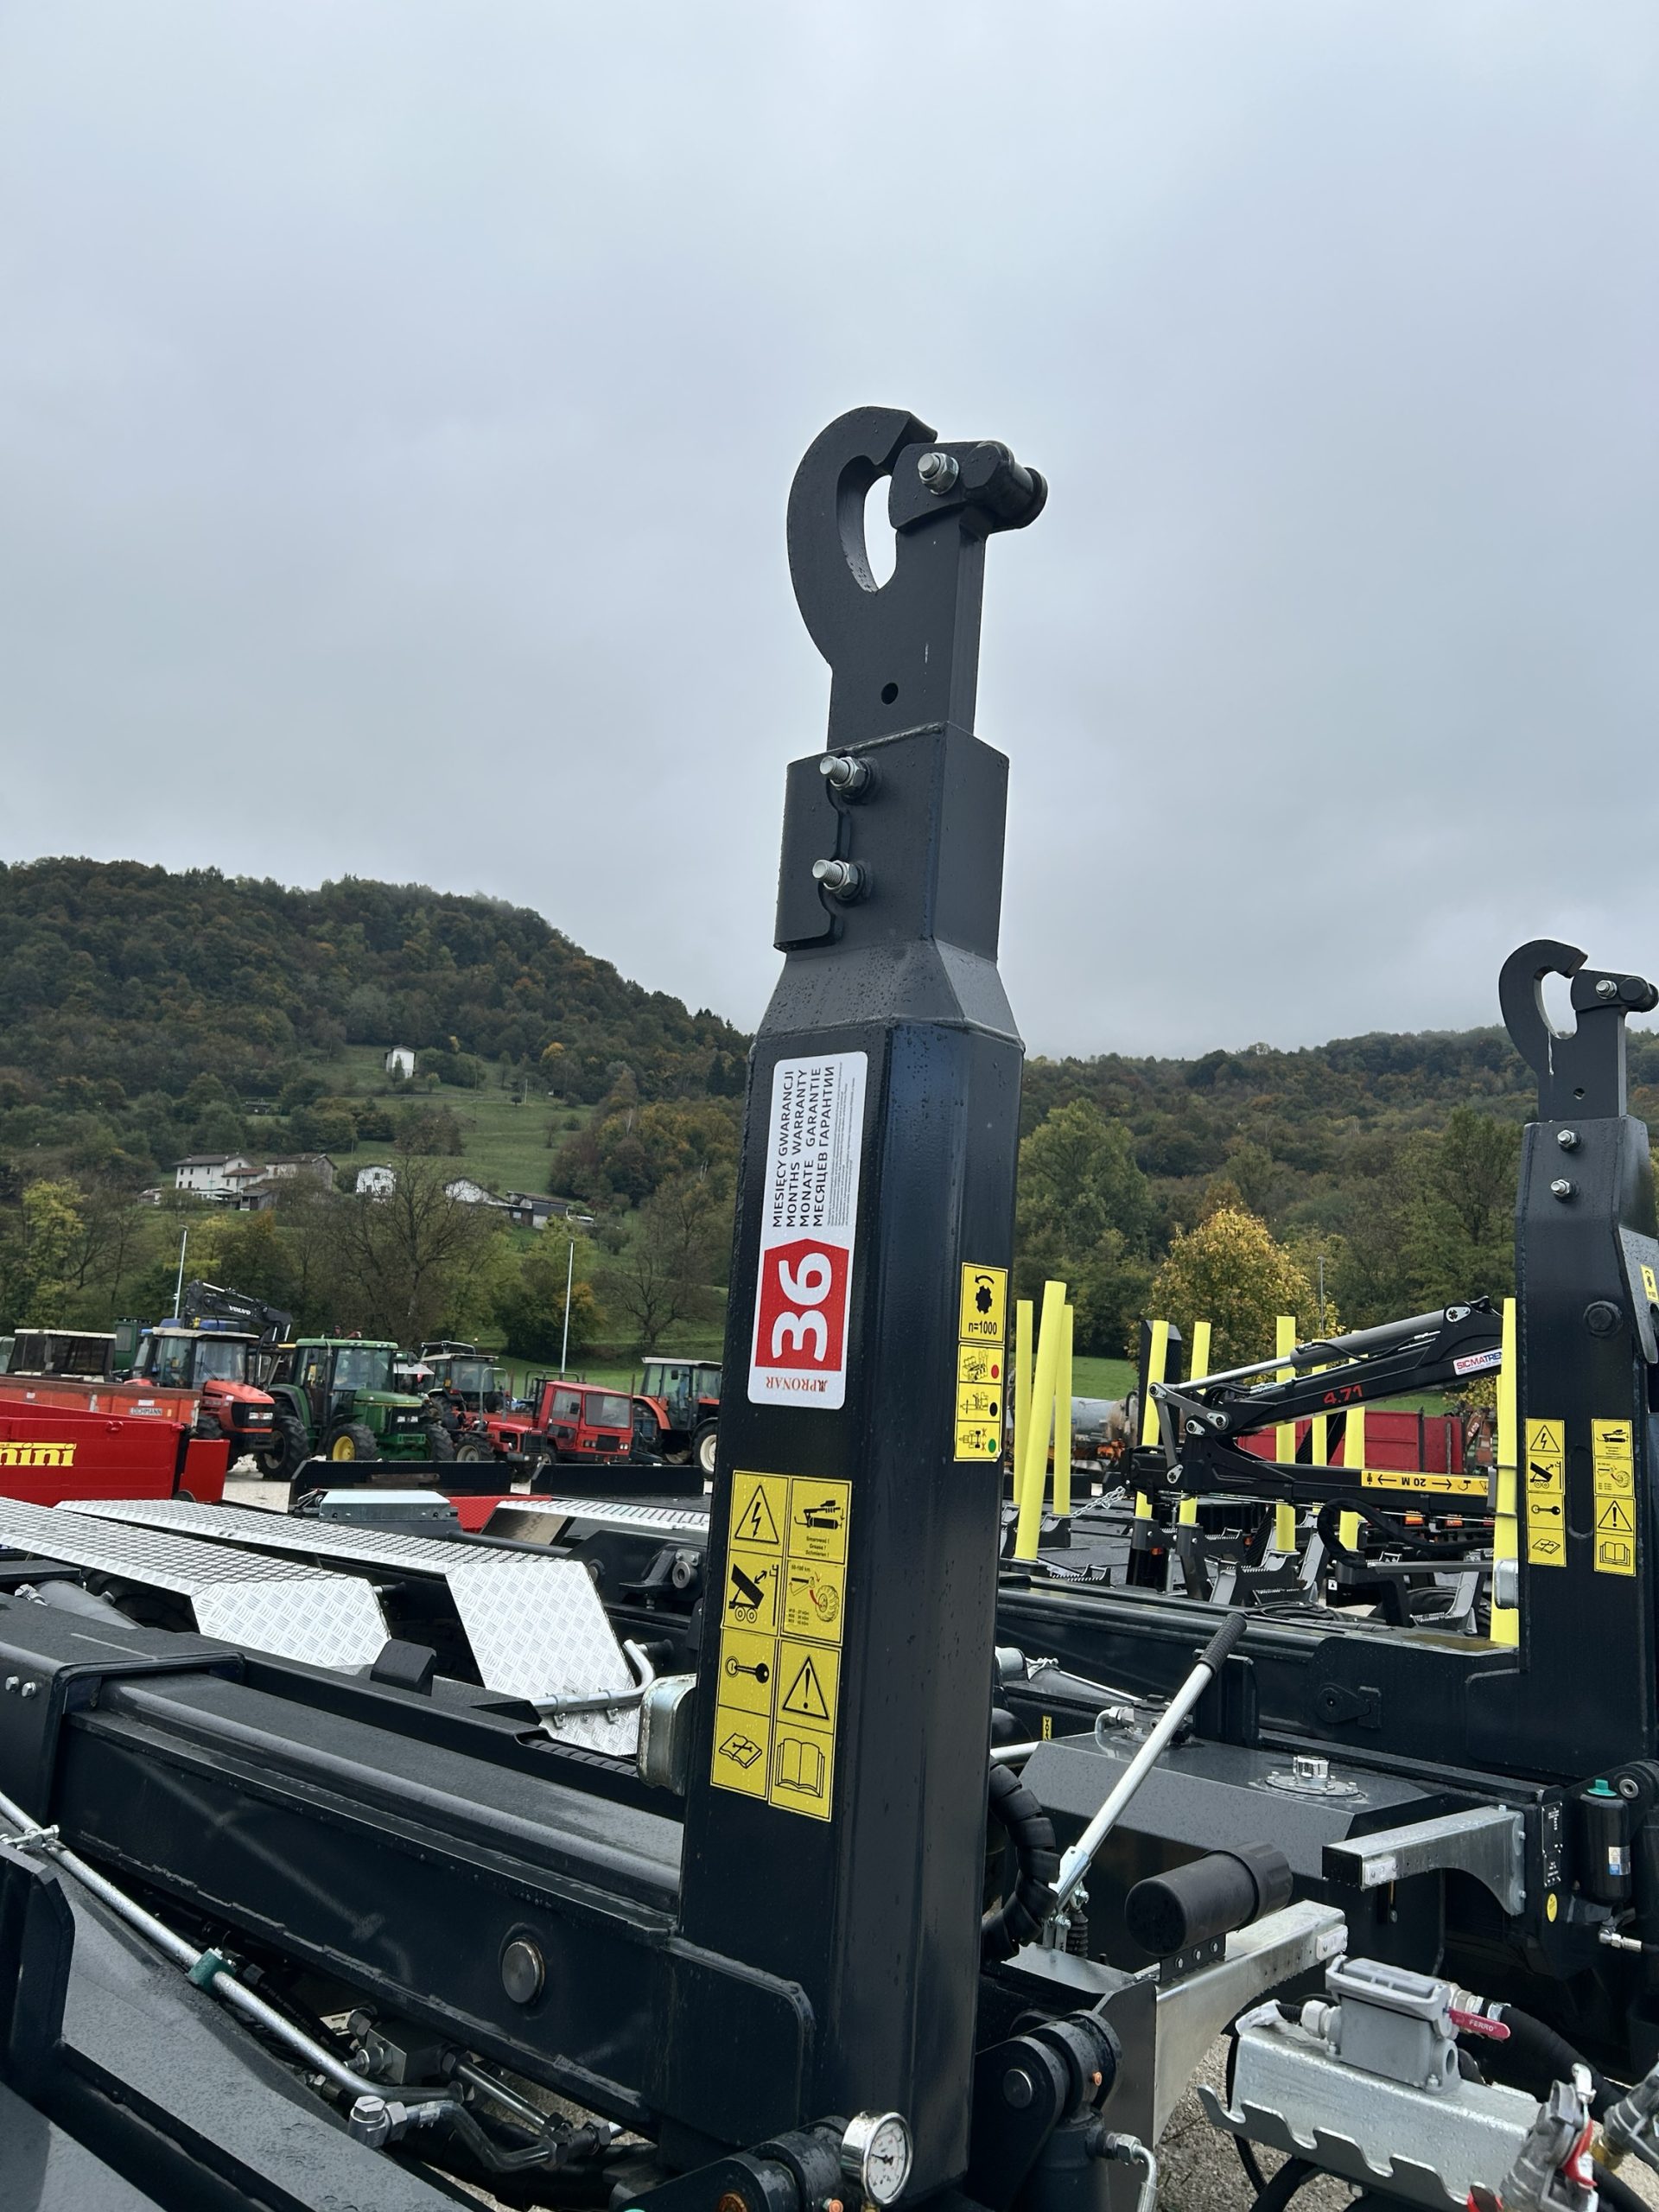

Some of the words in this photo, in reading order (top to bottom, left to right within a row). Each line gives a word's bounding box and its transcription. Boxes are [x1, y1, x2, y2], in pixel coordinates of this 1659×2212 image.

[779, 1071, 794, 1156] GWARANCJI
[792, 1070, 807, 1155] WARRANTY
[819, 1066, 834, 1147] ГАРАНТИИ
[799, 1160, 813, 1227] MONATE
[806, 1068, 821, 1147] GARANTIE
[772, 1160, 787, 1227] MIESIĘCY
[786, 1162, 799, 1227] MONTHS
[813, 1152, 828, 1227] МЕСЯЦЕВ
[228, 1303, 251, 1315] VOLVO
[772, 1253, 832, 1362] 36
[968, 1320, 997, 1335] n=1000
[766, 1376, 819, 1392] PRONAR
[1324, 1384, 1363, 1404] 4.71
[1401, 1477, 1410, 1485] M
[1414, 1478, 1427, 1487] 20
[1469, 2019, 1494, 2032] FERRO
